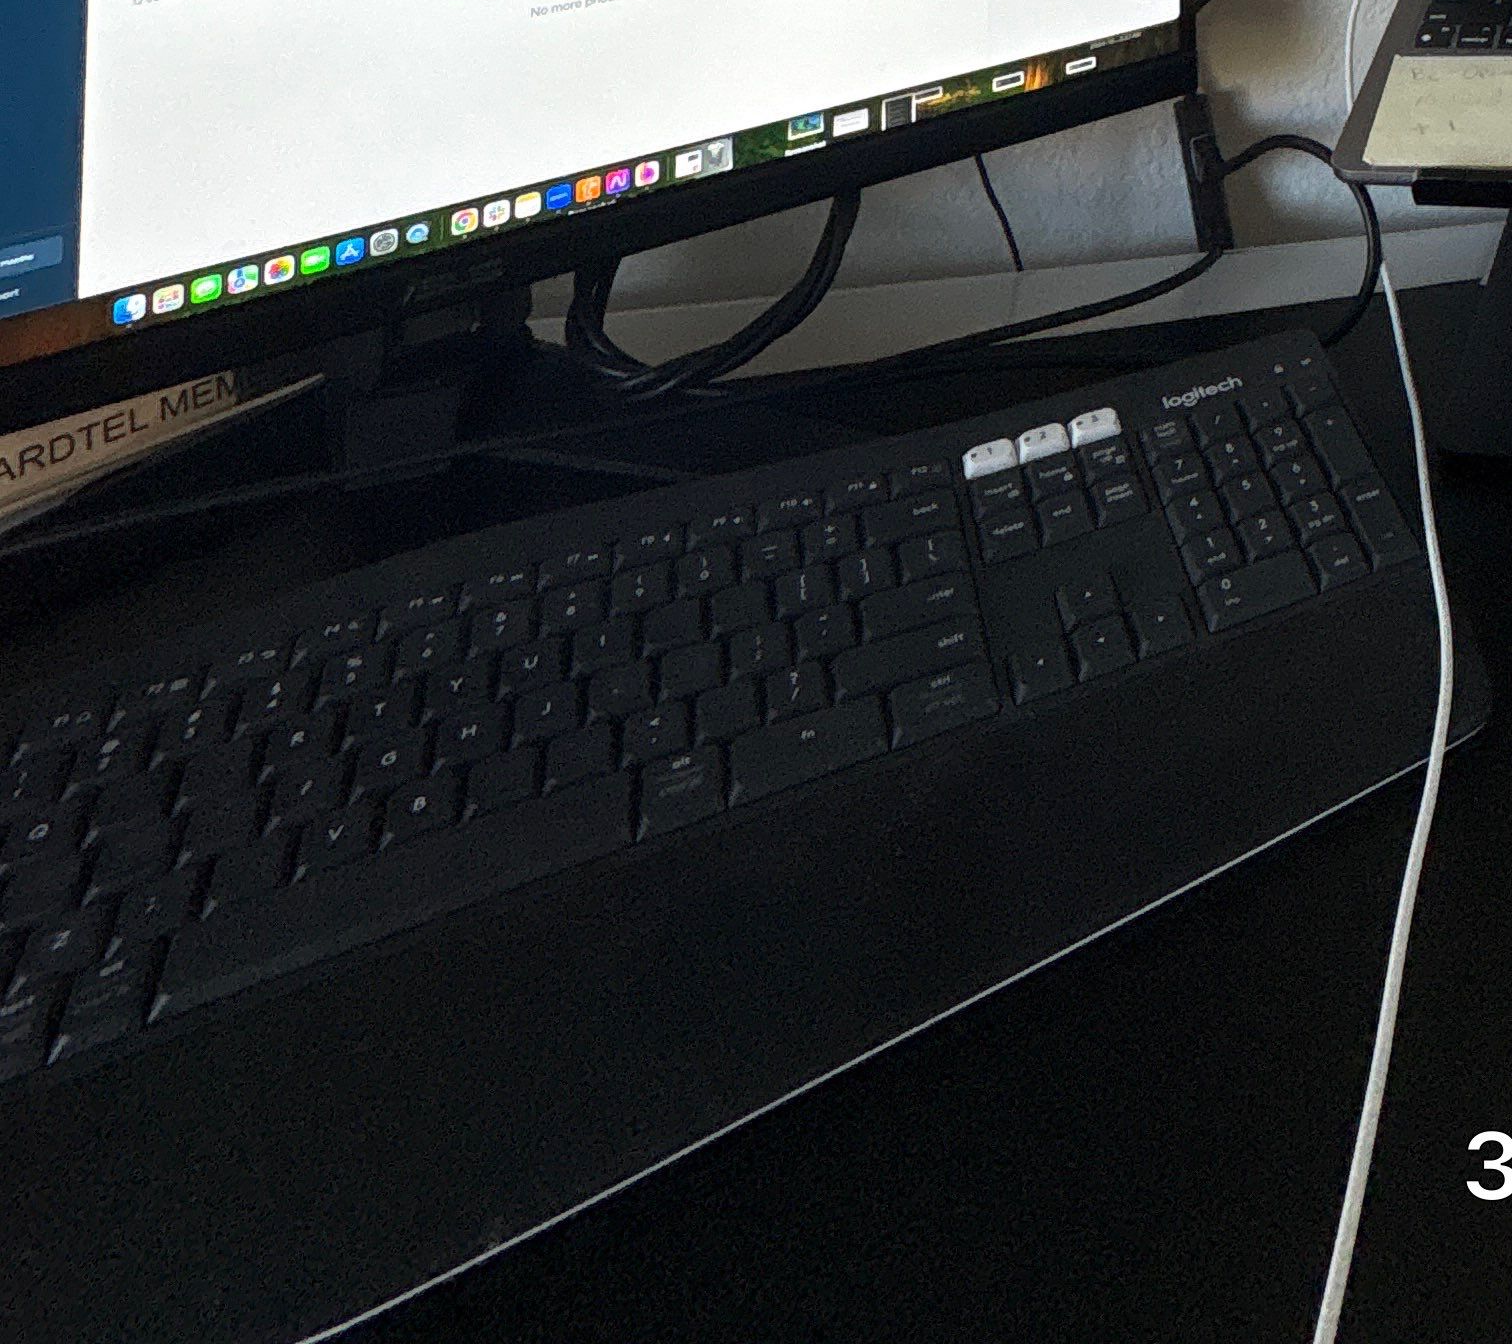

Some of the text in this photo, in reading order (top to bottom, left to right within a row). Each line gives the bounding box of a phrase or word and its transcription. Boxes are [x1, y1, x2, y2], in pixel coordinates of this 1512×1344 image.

[530, 6, 549, 18] No
[551, 0, 582, 13] more
[1162, 376, 1243, 409] logitech
